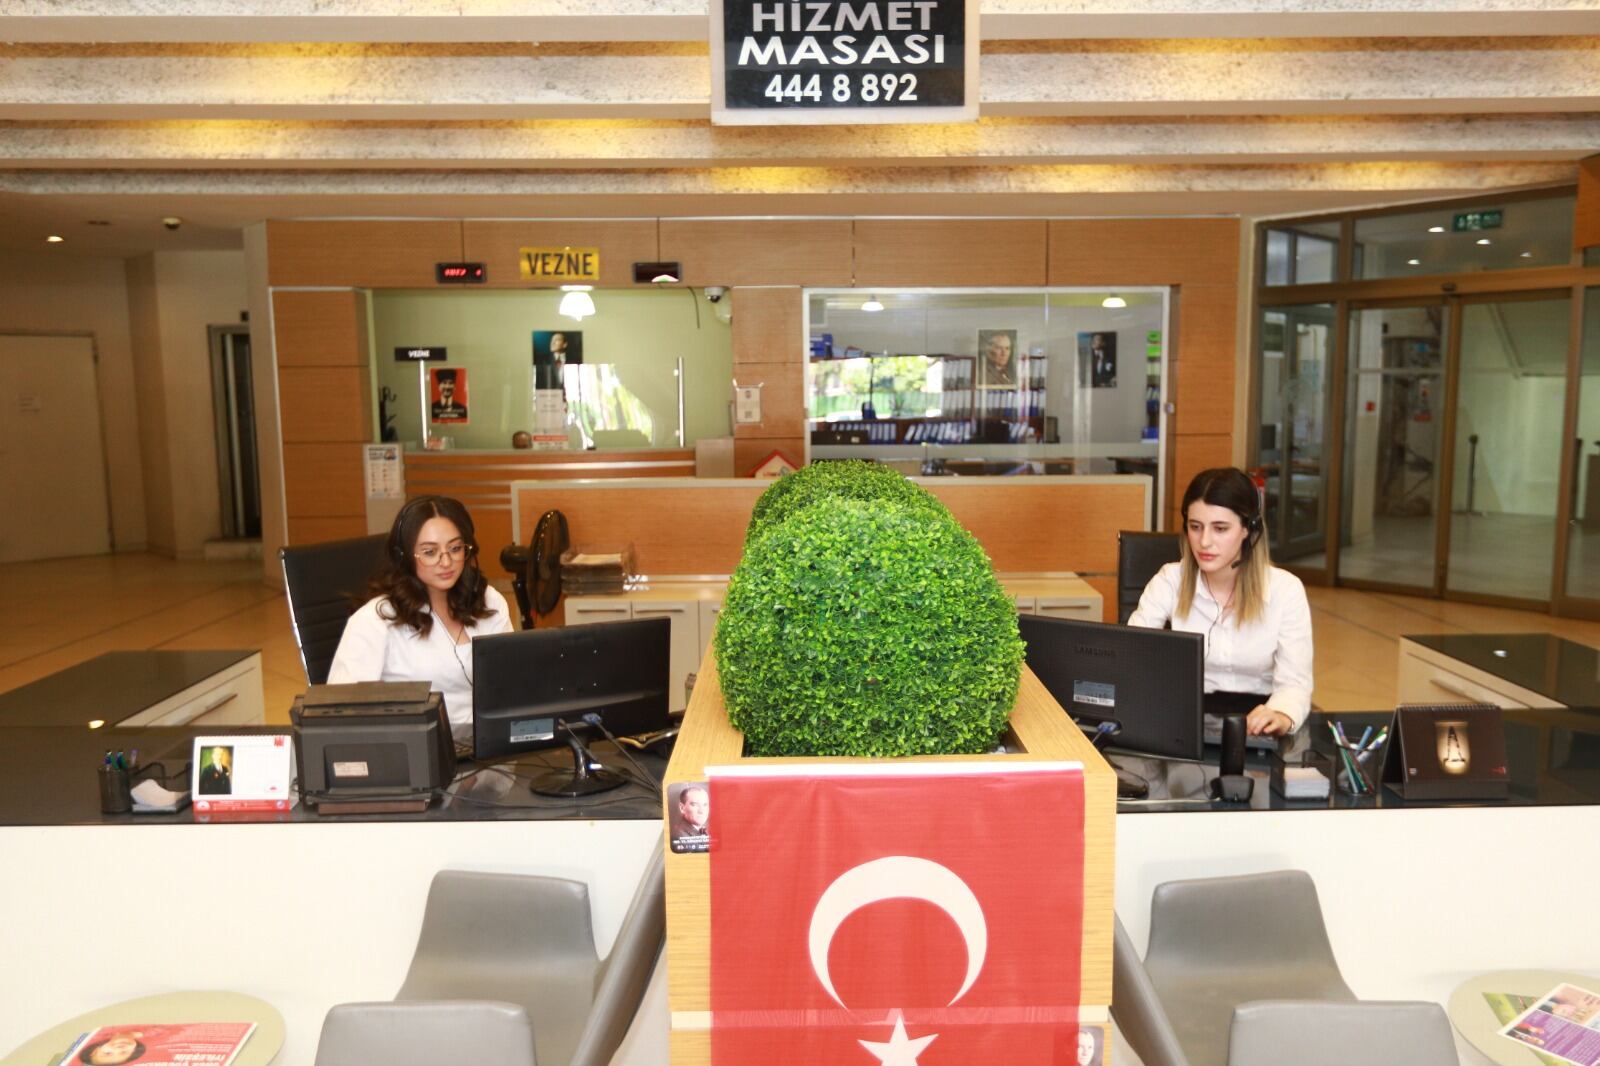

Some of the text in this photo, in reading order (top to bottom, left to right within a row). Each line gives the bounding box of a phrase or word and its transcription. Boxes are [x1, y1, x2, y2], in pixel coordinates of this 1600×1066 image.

[752, 0, 939, 32] HİZMET
[738, 34, 945, 65] MASASI
[765, 73, 918, 102] 444 8 892
[526, 253, 593, 275] VEZNE
[407, 349, 431, 358] VEZNE
